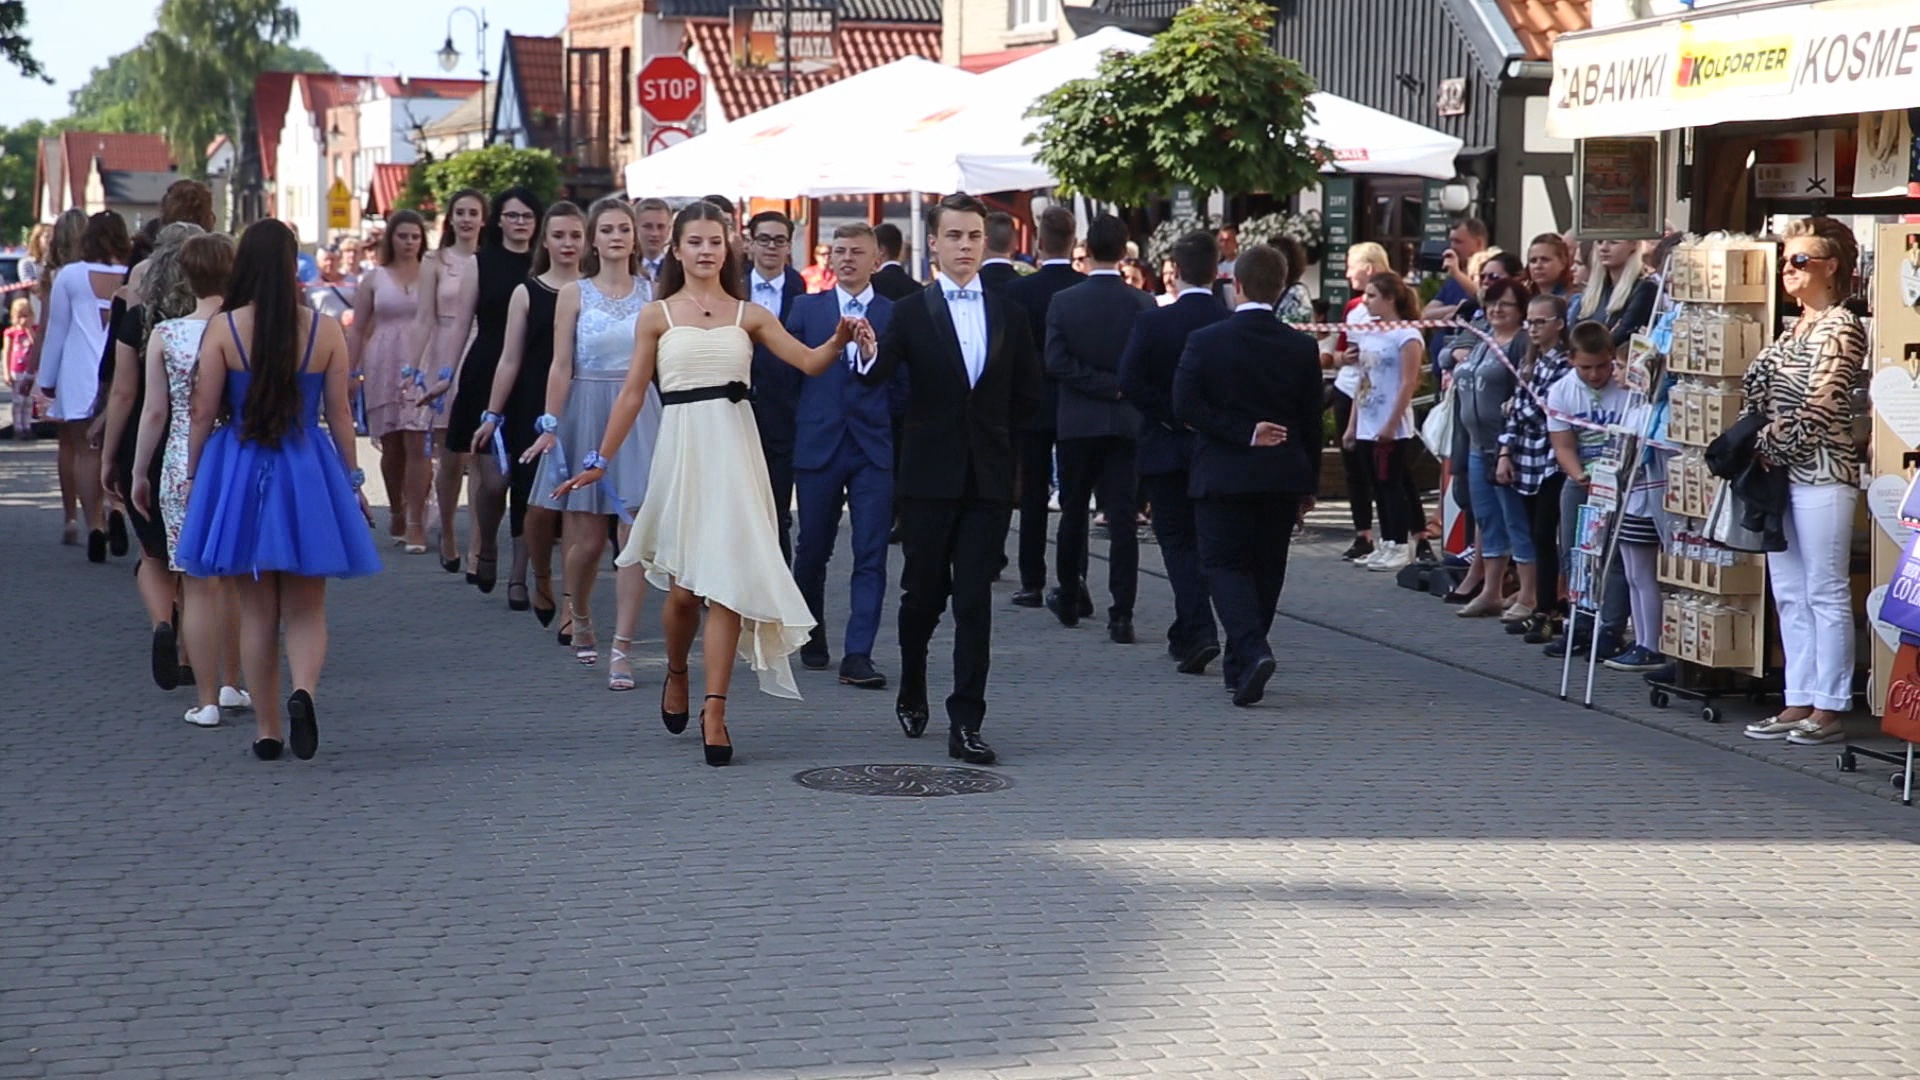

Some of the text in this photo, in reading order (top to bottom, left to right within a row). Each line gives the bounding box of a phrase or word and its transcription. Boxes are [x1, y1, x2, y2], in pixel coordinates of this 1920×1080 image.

[751, 10, 832, 33] ALKHOLE
[1690, 47, 1787, 87] KOLPORTER
[1799, 24, 1920, 86] KOSME
[643, 77, 697, 101] STOP
